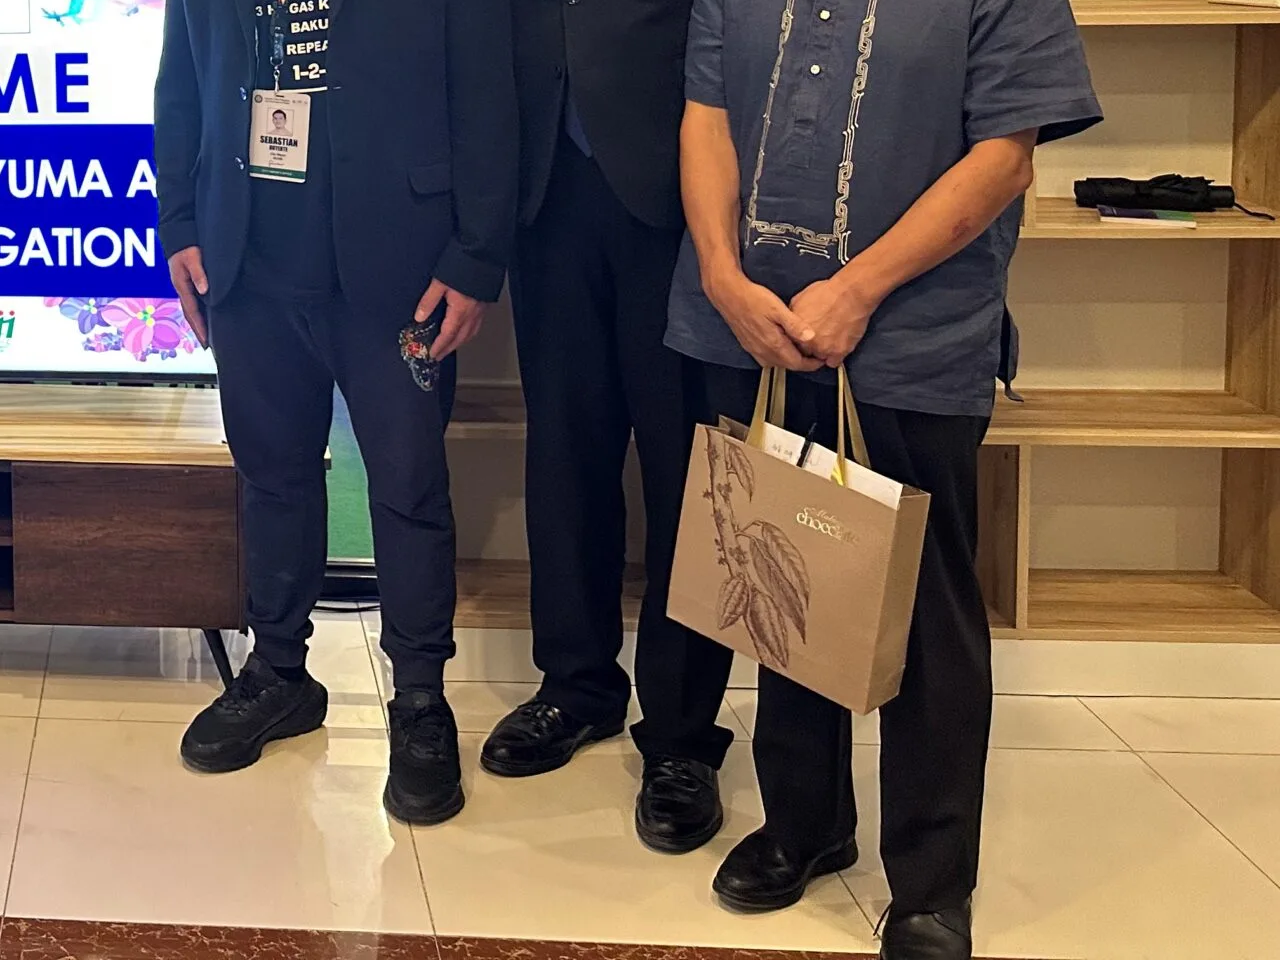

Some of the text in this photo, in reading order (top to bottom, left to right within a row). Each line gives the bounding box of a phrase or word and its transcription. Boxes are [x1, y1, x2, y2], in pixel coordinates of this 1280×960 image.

[291, 19, 329, 33] BAKU
[260, 136, 298, 147] SEBASTIAN
[126, 158, 158, 198] A
